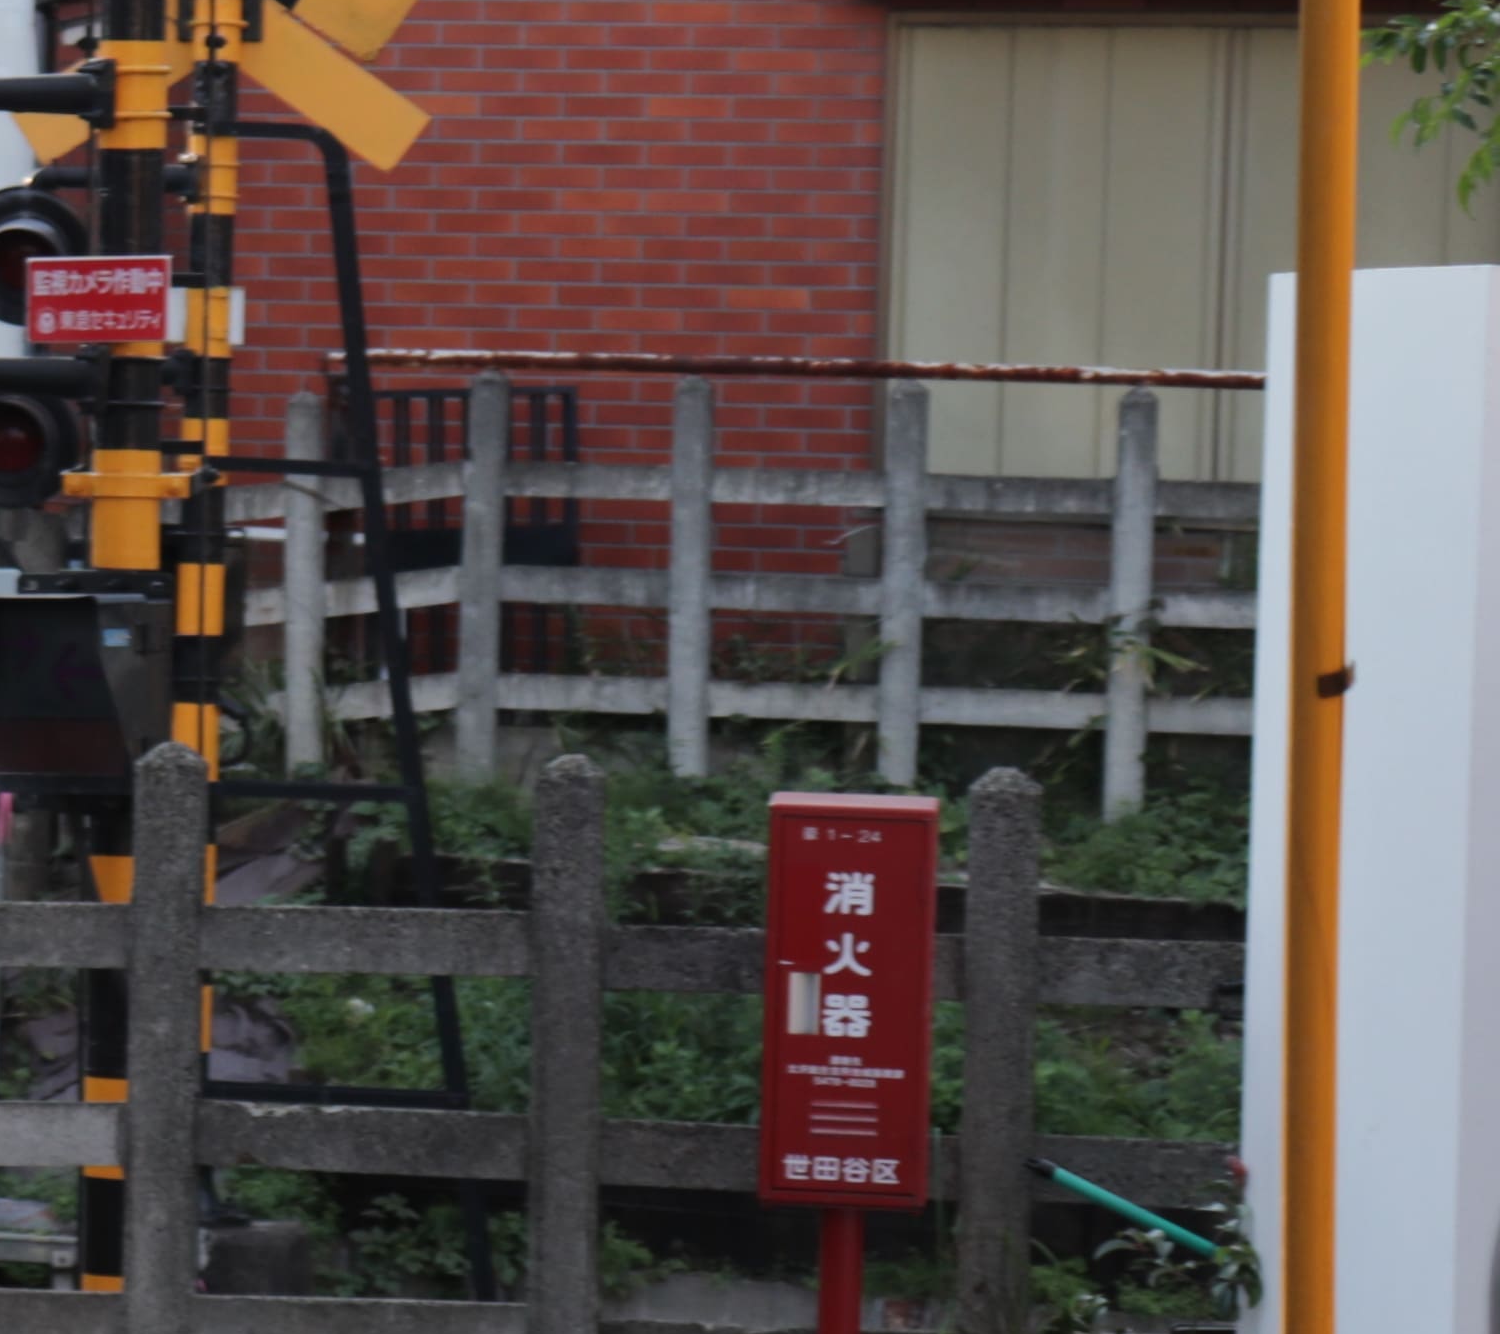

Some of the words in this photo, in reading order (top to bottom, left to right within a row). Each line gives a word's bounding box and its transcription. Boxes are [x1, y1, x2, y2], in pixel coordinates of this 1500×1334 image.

[823, 871, 876, 1039] 消火器
[782, 1154, 901, 1185] 世田谷区
